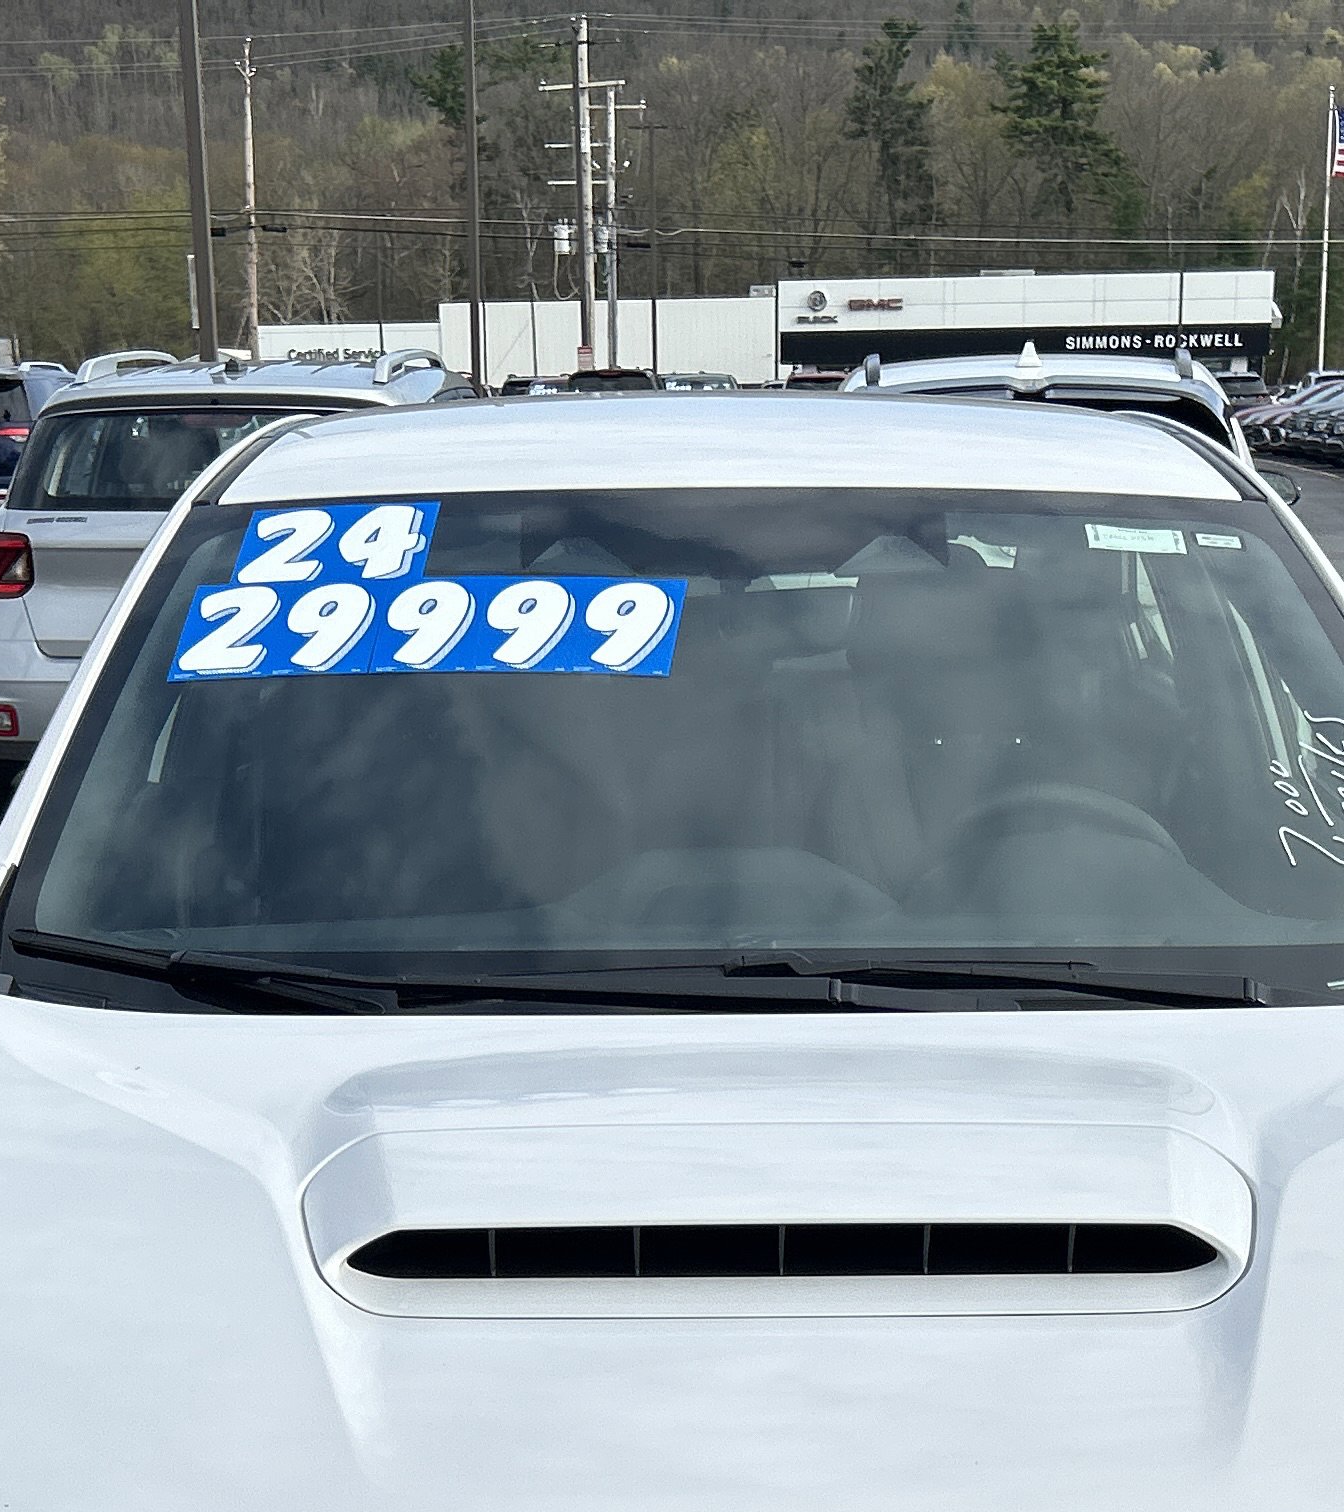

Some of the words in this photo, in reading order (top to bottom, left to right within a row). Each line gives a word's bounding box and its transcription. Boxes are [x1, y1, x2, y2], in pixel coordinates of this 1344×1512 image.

[848, 298, 903, 311] GMC
[237, 505, 426, 584] 24
[179, 580, 675, 673] 29999
